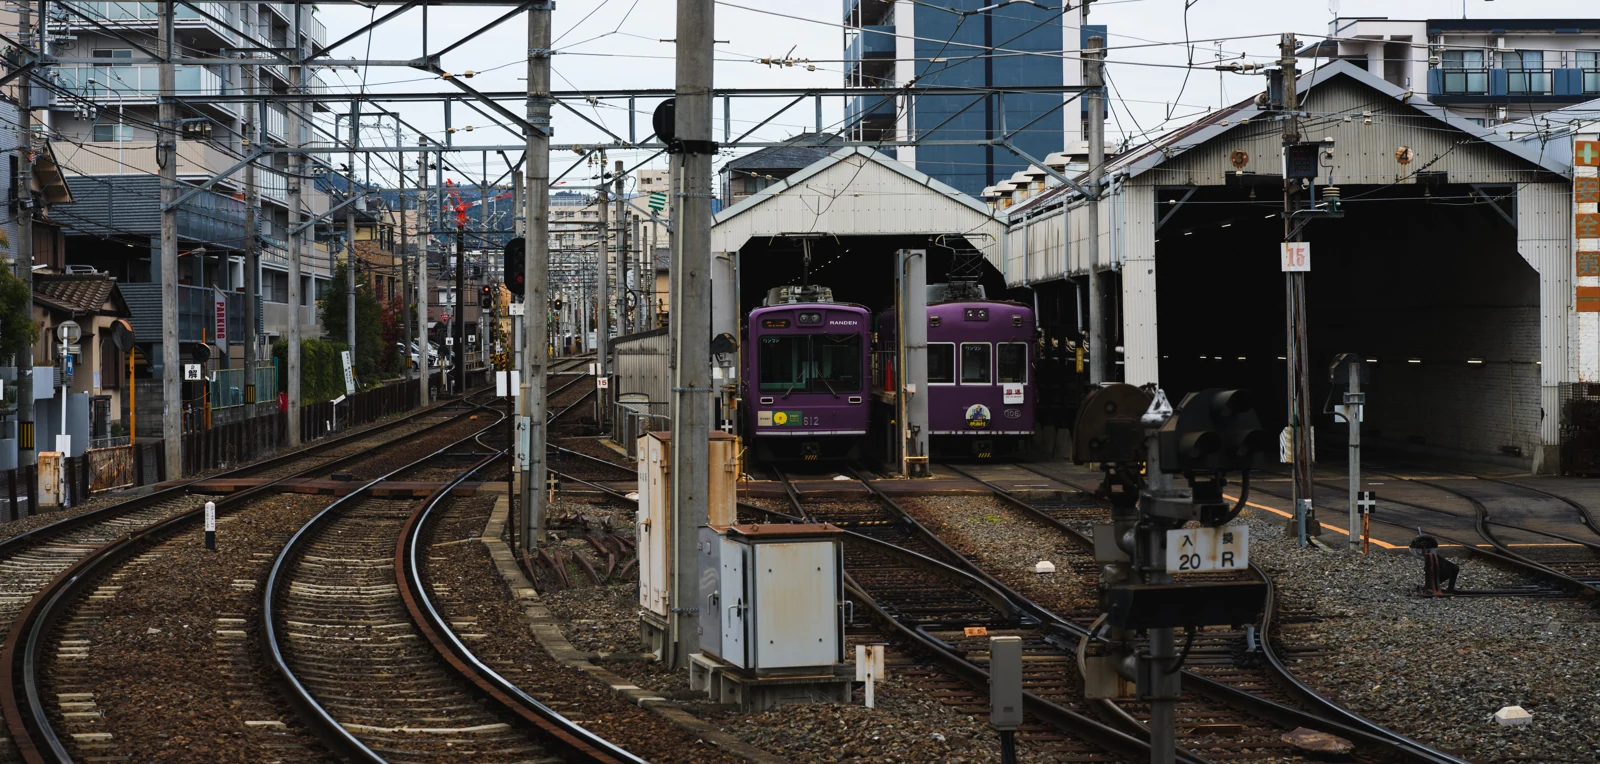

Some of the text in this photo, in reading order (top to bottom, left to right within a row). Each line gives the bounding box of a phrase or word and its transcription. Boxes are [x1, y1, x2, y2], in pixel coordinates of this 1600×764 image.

[1234, 151, 1244, 165] 3
[1399, 148, 1409, 160] 4
[1577, 178, 1600, 302] 安全第一
[1287, 247, 1305, 267] 15
[216, 301, 226, 339] PARKING
[803, 416, 819, 426] 612
[1179, 551, 1234, 570] 20 R
